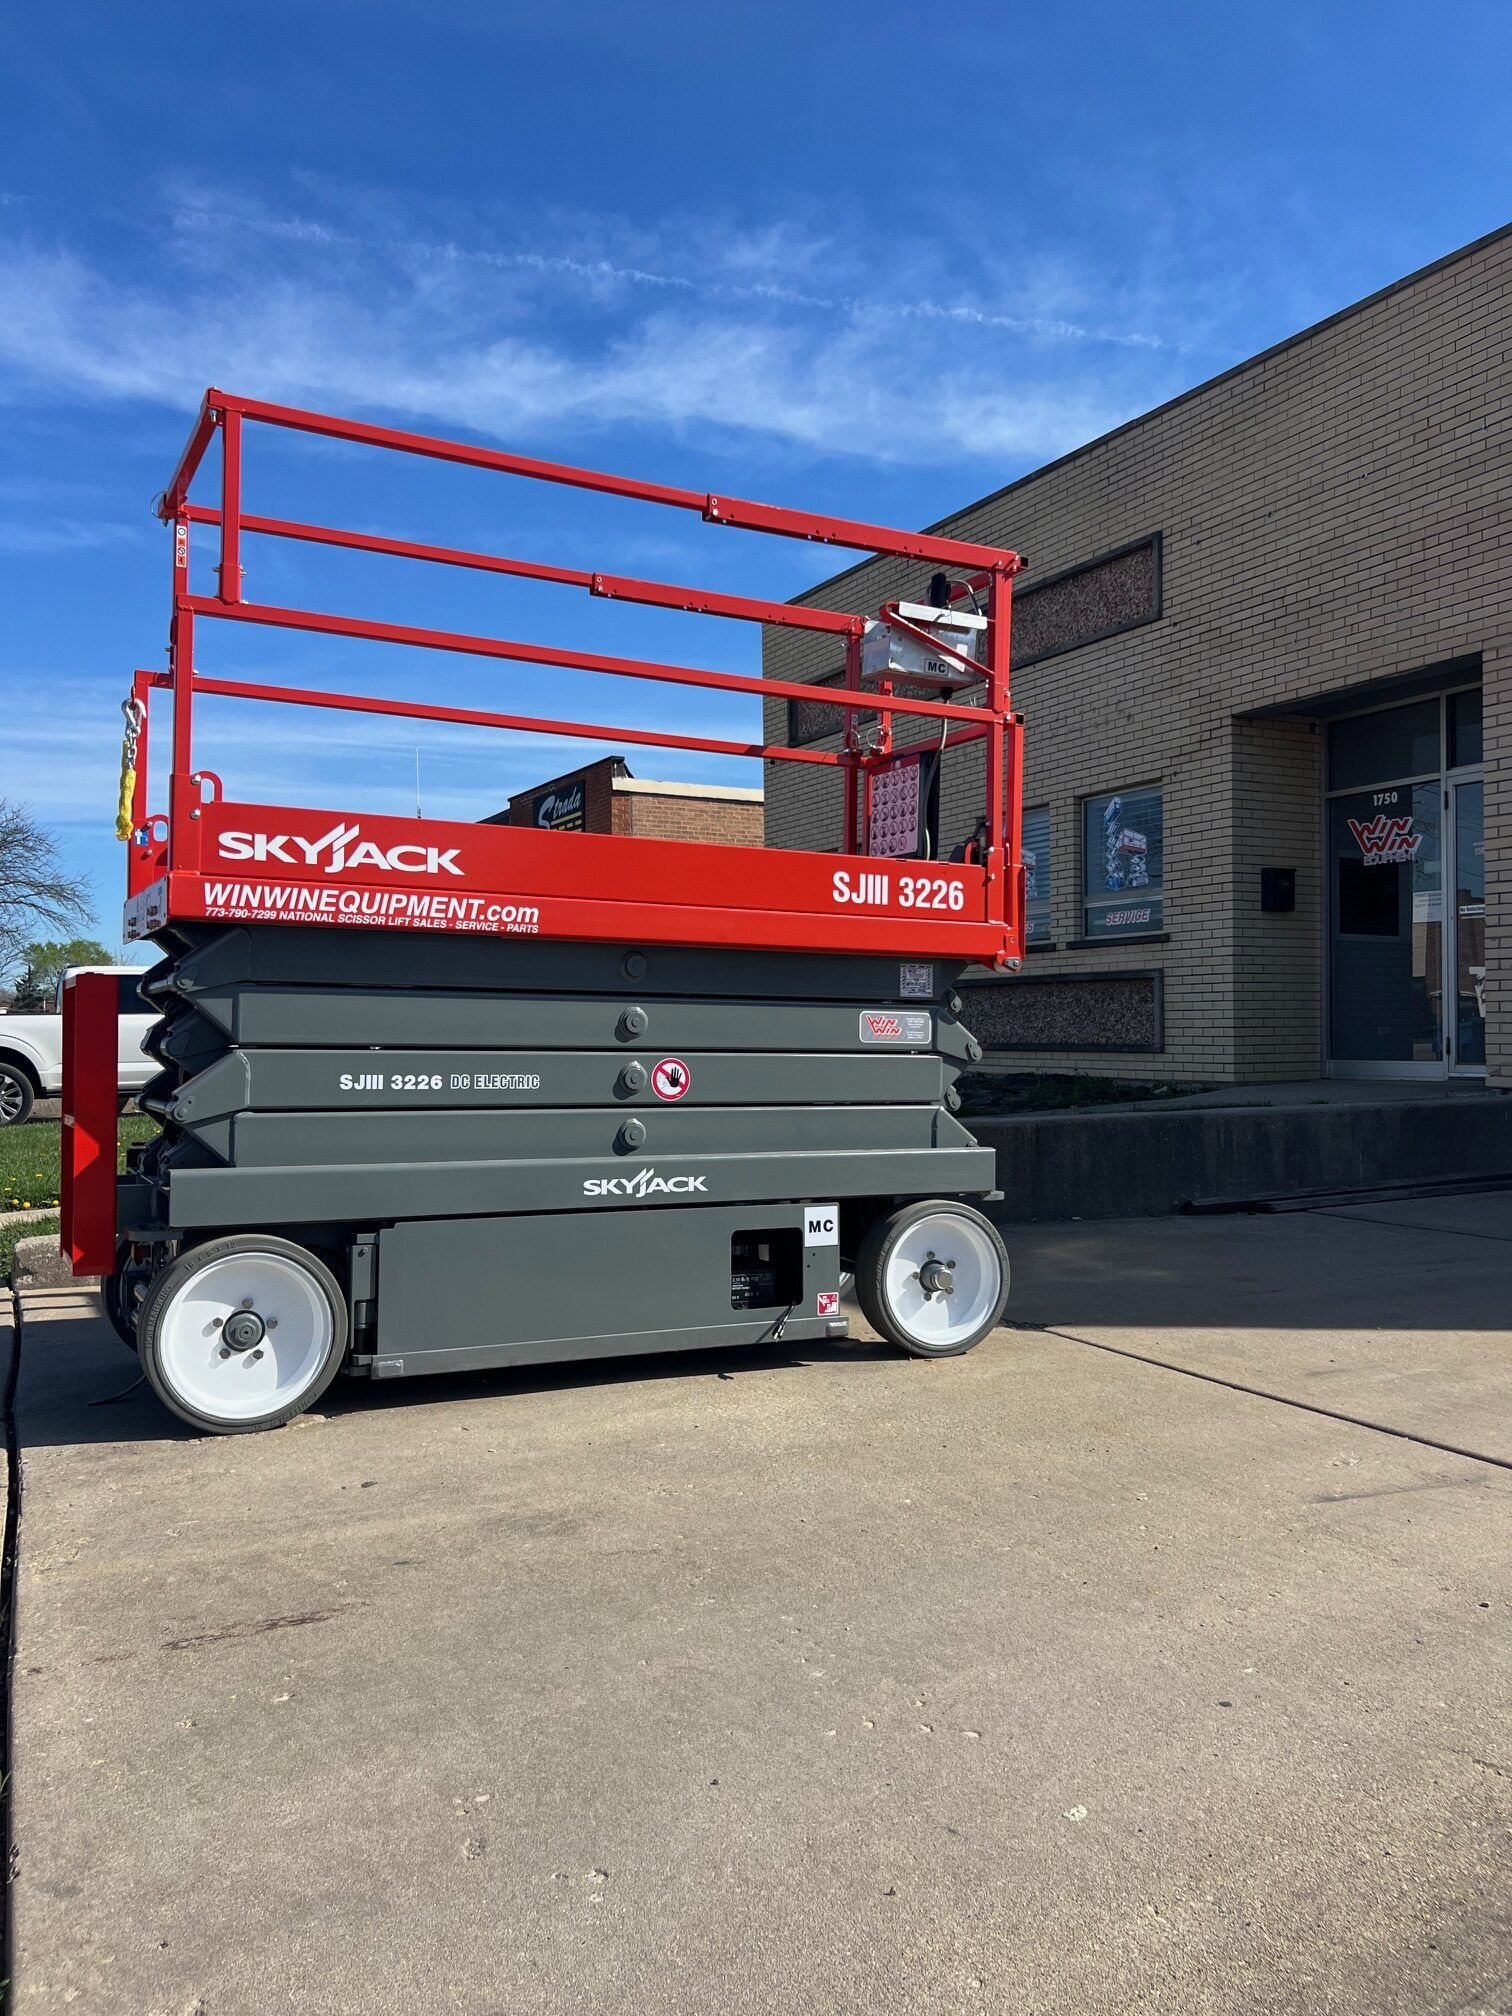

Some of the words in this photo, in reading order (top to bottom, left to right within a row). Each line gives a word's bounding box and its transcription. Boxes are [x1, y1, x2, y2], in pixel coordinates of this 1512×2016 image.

[928, 661, 946, 674] MC
[1372, 791, 1398, 807] 1750
[1347, 814, 1413, 839] WIN
[218, 822, 466, 876] SKYJACK
[1360, 833, 1423, 855] WIN
[832, 872, 889, 905] SJIII
[899, 878, 964, 910] 3226
[204, 882, 540, 924] WINWINEQUIPMENT.com
[205, 906, 277, 920] 773-790-7299
[279, 910, 335, 923] NATIONAL
[338, 914, 386, 926] SCISSOR
[387, 917, 412, 927] LIFT
[413, 918, 448, 929] SALES
[455, 920, 500, 932] SERVICE
[506, 923, 540, 934] PARTS
[1105, 908, 1151, 926] SERVICE
[339, 1073, 384, 1091] SJIII
[390, 1074, 443, 1091] 3226
[450, 1074, 471, 1090] DC
[473, 1074, 541, 1090] ELECTRIC
[582, 1168, 709, 1198] SKYJACK
[808, 1219, 834, 1234] MC
